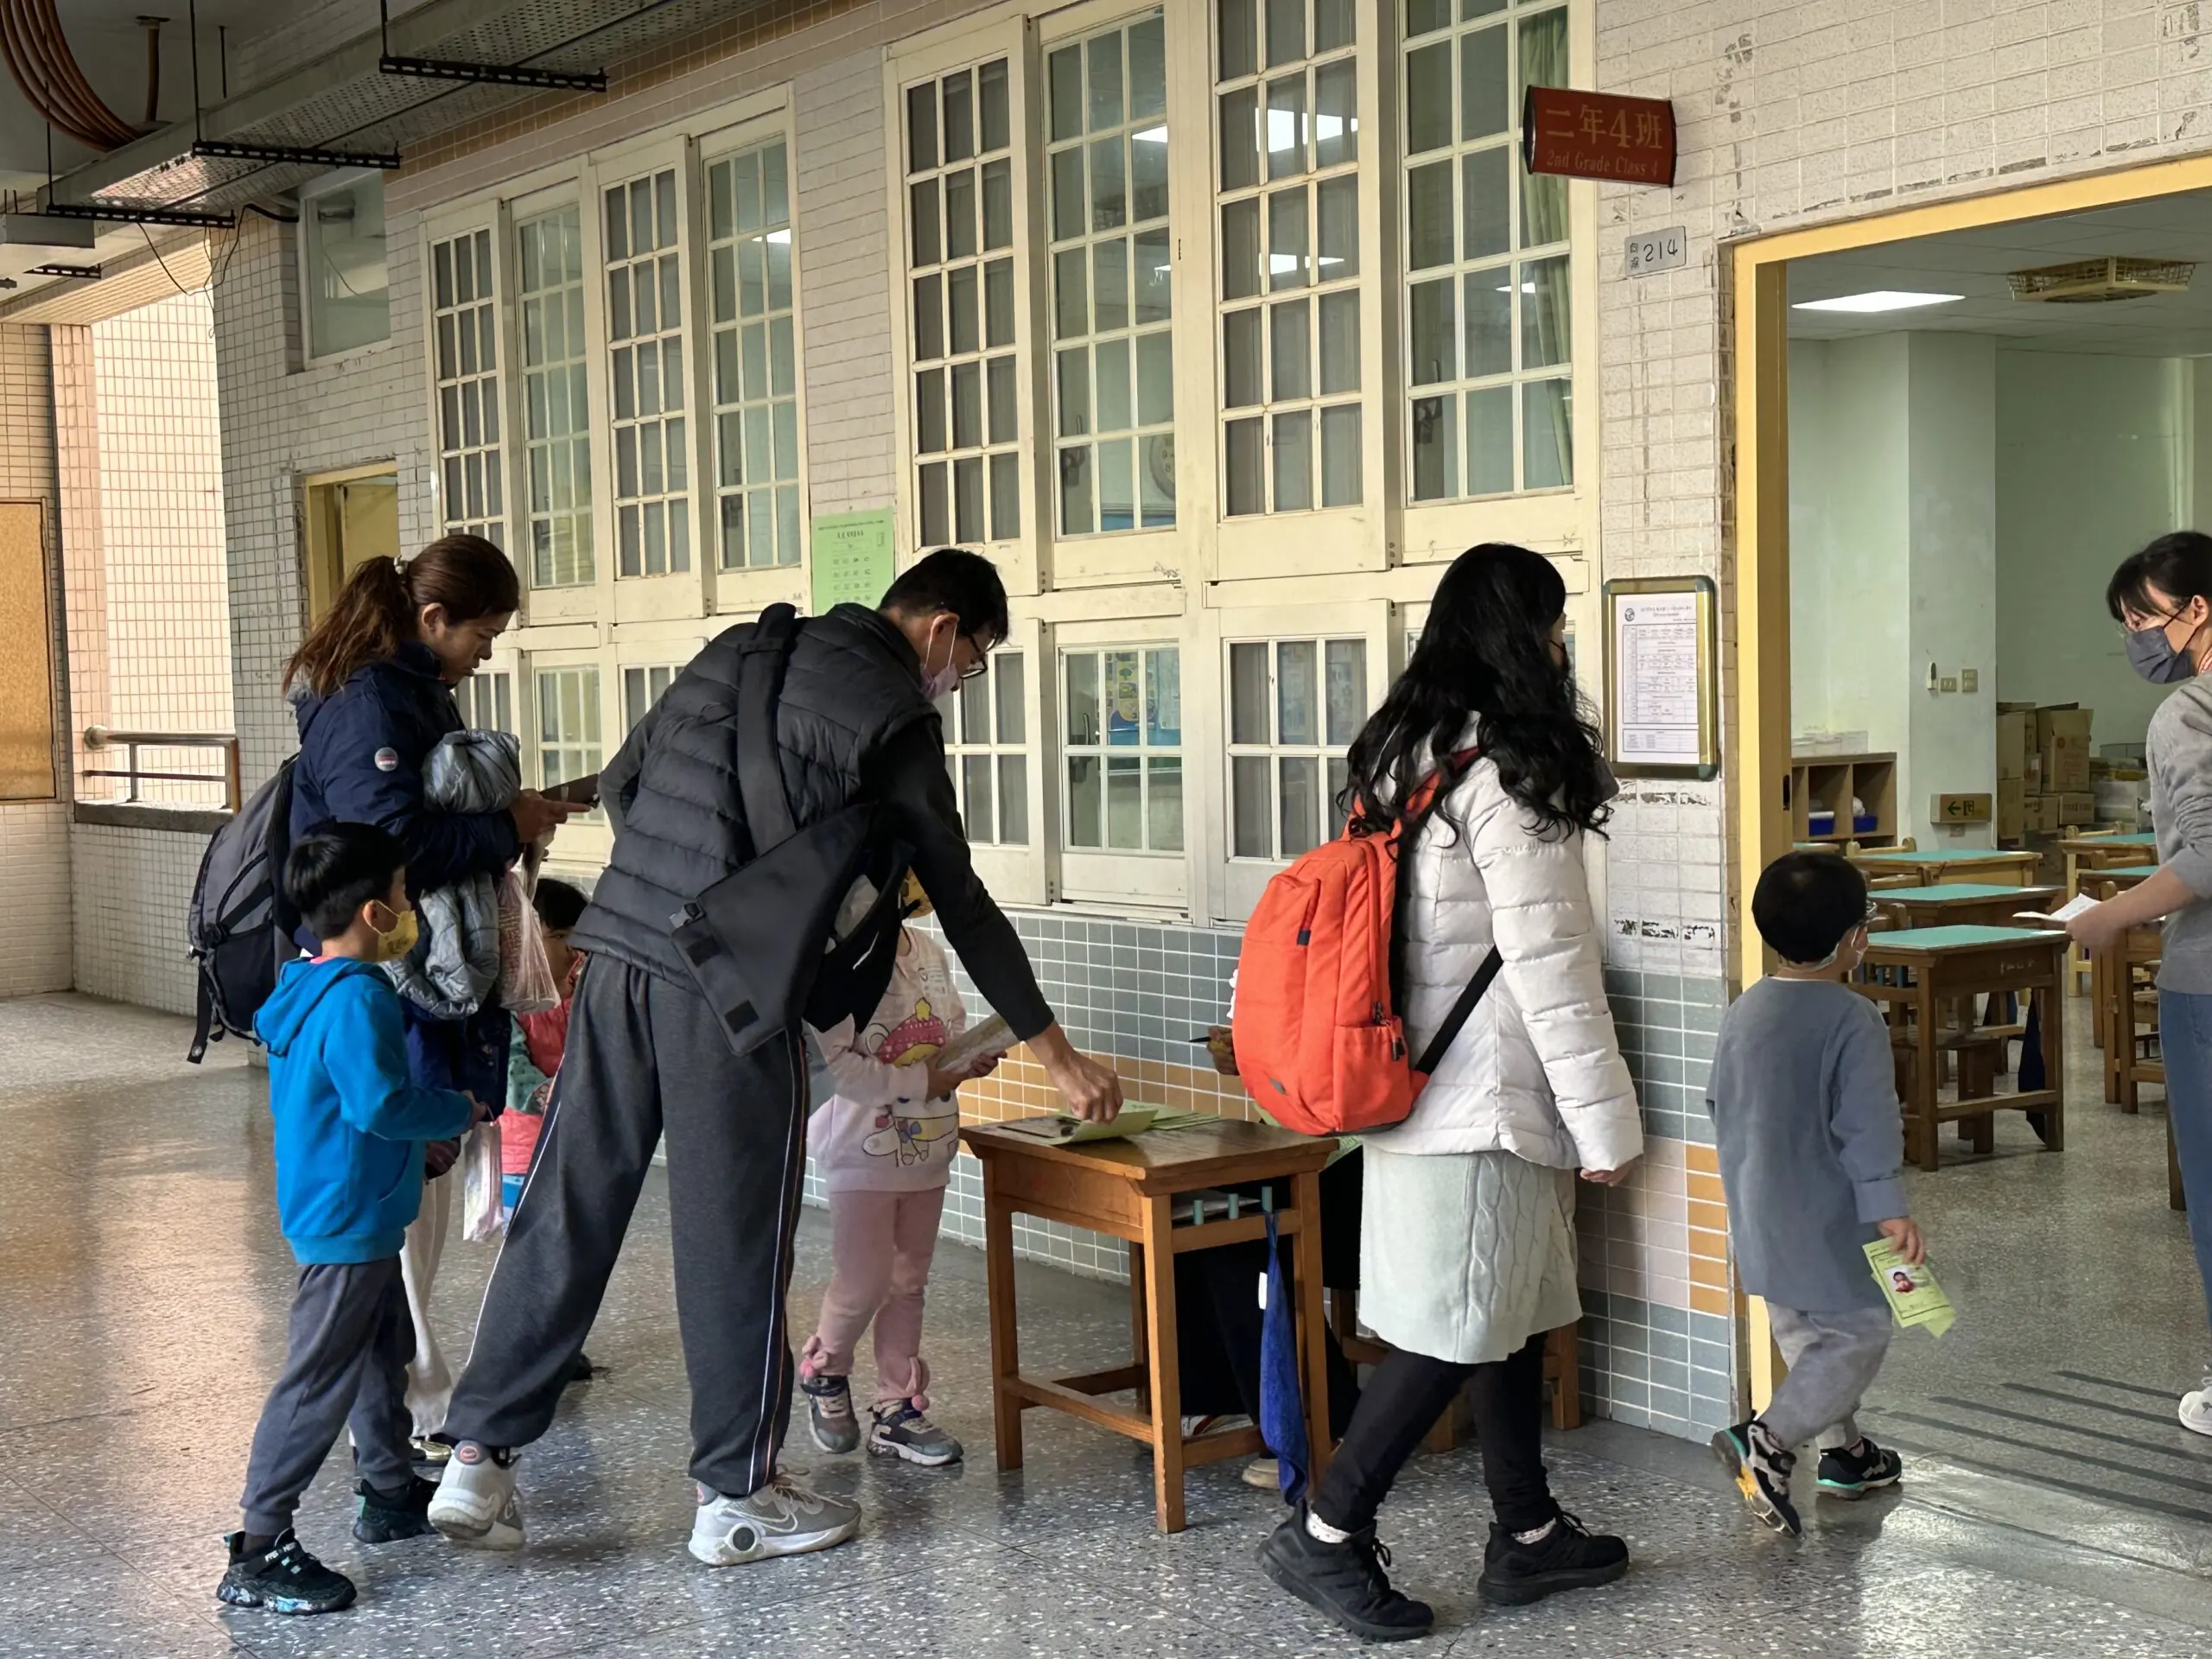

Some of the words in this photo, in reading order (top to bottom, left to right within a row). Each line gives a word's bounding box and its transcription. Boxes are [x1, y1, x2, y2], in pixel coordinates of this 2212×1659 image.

[1545, 104, 1663, 149] 二年4班
[1546, 149, 1570, 169] 2nd
[1574, 150, 1611, 173] Grade
[1615, 156, 1647, 176] Class
[1643, 238, 1678, 262] 214
